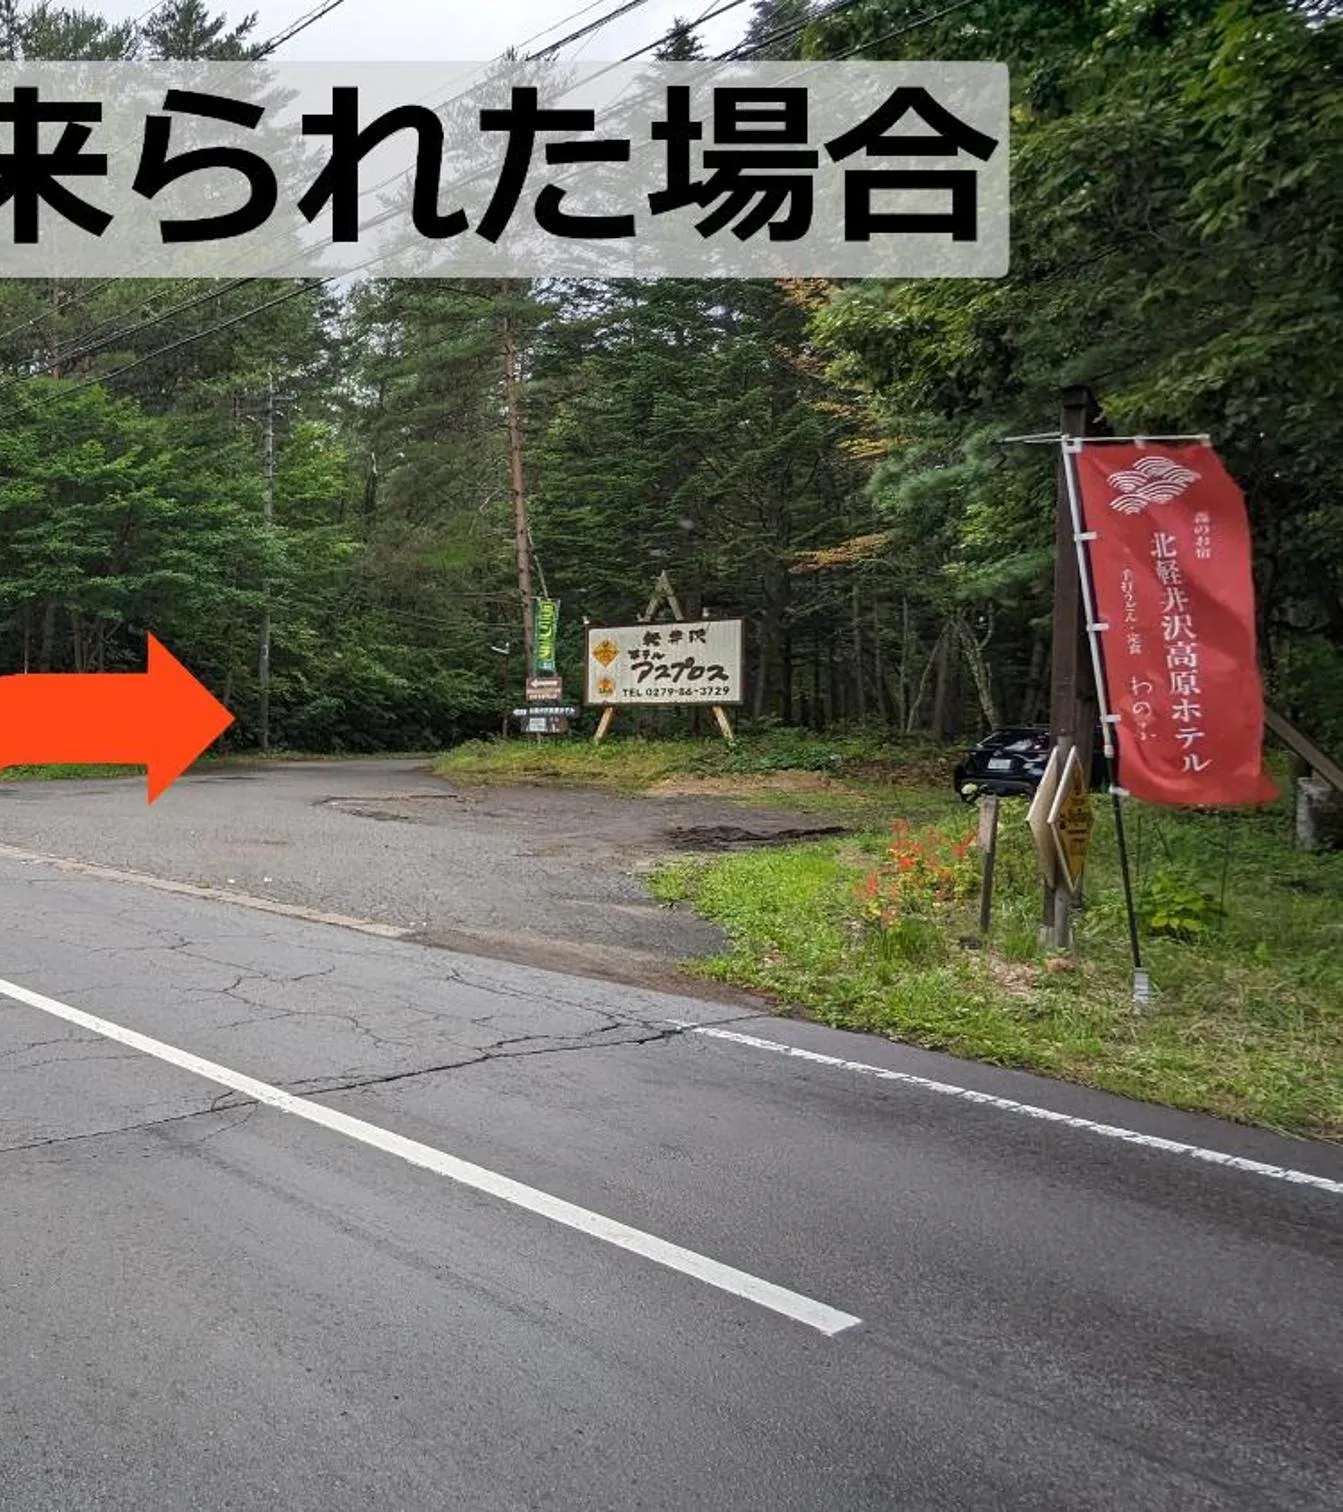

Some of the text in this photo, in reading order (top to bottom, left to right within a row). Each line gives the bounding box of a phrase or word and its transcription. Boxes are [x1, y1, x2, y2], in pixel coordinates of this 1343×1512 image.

[622, 688, 643, 697] TEL
[1149, 531, 1212, 774] 北軽井沢高原ホテル
